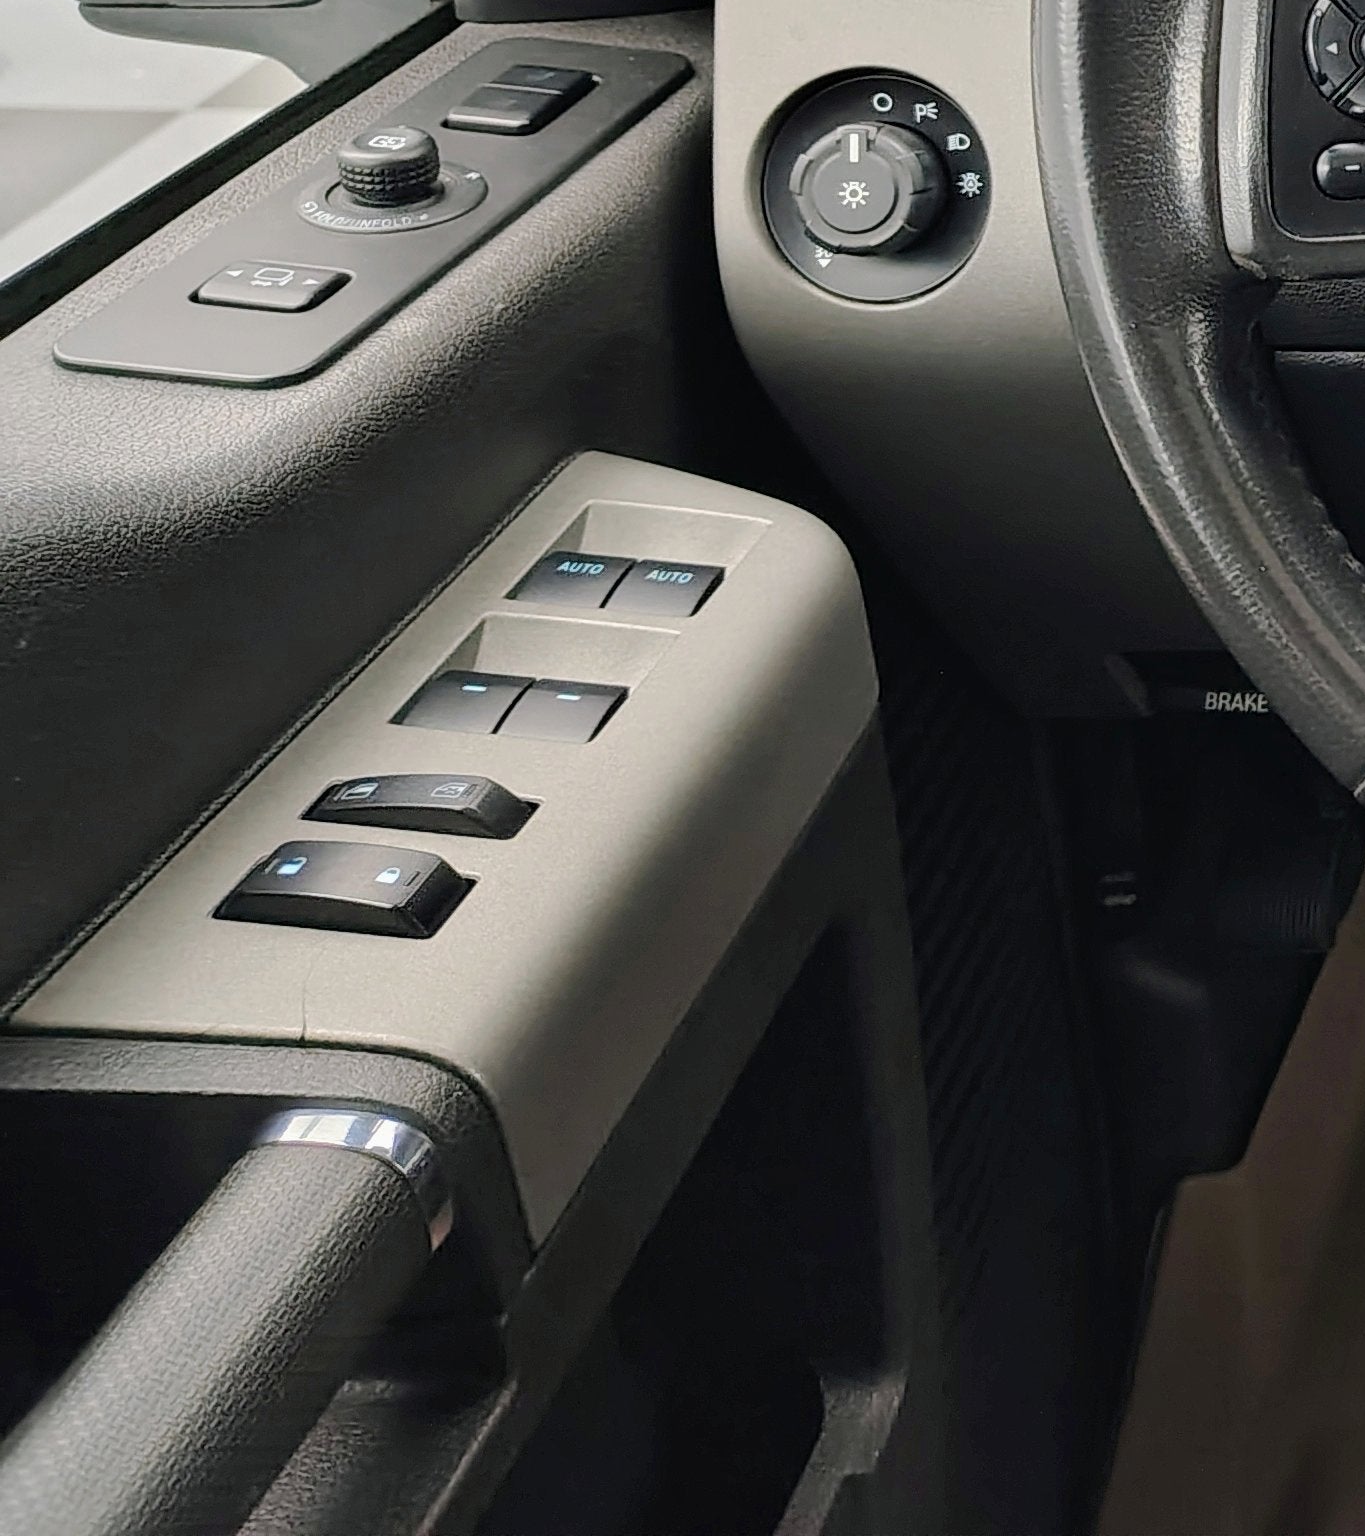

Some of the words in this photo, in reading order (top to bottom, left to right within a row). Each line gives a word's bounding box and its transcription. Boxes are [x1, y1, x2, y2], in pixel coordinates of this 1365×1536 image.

[556, 560, 605, 575] AUTO
[644, 569, 695, 585] AUTO
[1203, 690, 1270, 714] BRAKE
